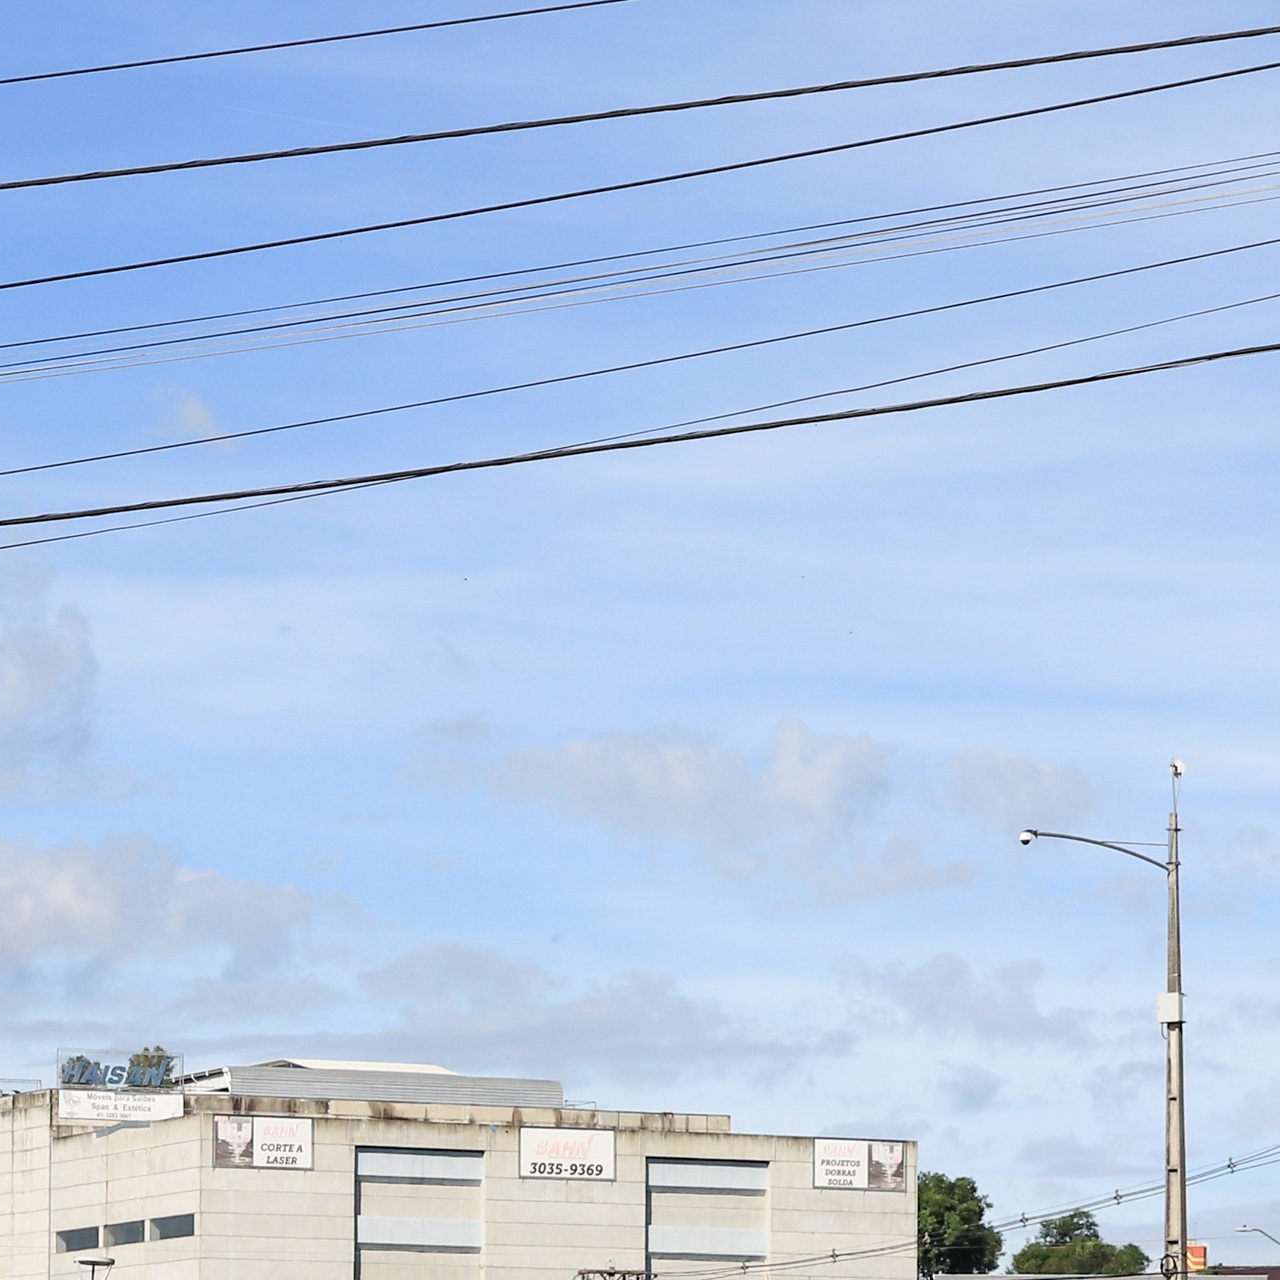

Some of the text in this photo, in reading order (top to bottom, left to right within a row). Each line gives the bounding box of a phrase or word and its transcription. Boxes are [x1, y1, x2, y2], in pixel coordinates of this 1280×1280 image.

[61, 1057, 175, 1087] HAISAN
[91, 1103, 110, 1111] Spas
[260, 1143, 304, 1153] CORTE A
[265, 1156, 298, 1165] LASER
[820, 1159, 861, 1167] PROJETOS
[529, 1162, 604, 1176] 3035-9369
[824, 1169, 857, 1177] DOBRAS
[827, 1179, 854, 1187] SOLDA
